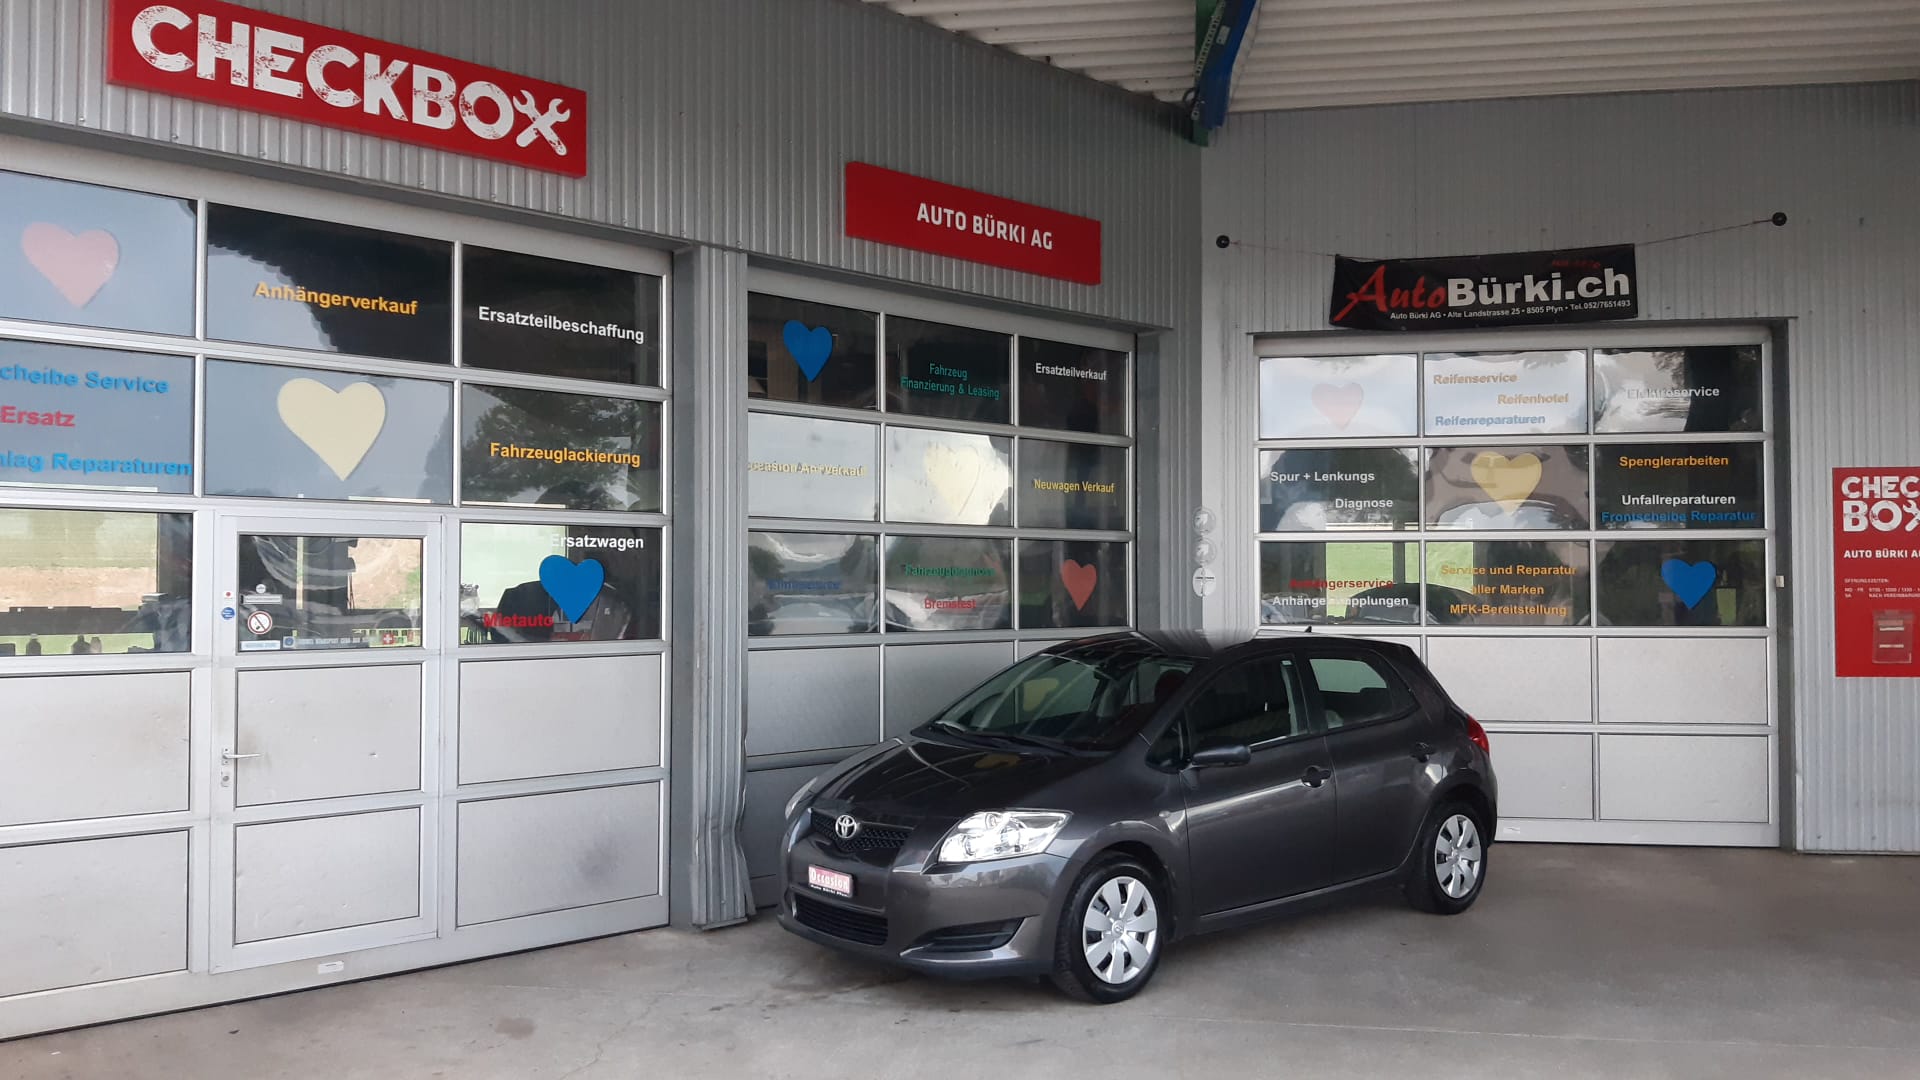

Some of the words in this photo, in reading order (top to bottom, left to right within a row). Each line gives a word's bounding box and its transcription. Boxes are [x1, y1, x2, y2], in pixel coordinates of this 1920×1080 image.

[131, 5, 571, 156] CHECKBOX
[917, 203, 967, 231] AUTO
[973, 214, 1025, 244] BÜRKI
[1031, 229, 1052, 250] AG
[255, 281, 418, 315] Anhängerverkauf
[1390, 312, 1408, 320] Auto
[1409, 311, 1429, 319] Bürki
[1463, 308, 1510, 318] Landstrasse
[1511, 307, 1521, 316] 25
[1526, 306, 1545, 315] 8505
[1545, 306, 1563, 315] Pfyn
[478, 306, 644, 344] Ersatzteilbeschaffung
[929, 363, 968, 381] Fahrzeug
[1035, 363, 1107, 381] Ersatzteilverkauf
[1433, 373, 1517, 385] Reifenservice
[85, 371, 169, 394] Service
[901, 376, 955, 394] Finanzierung
[958, 383, 965, 394] &
[968, 386, 1000, 400] Leasing
[1497, 393, 1569, 405] Reifenhotel
[0, 406, 76, 427] Ersatz
[1435, 414, 1545, 427] Reifenreparaturen
[490, 442, 641, 468] Fahrzeuglackierung
[1619, 456, 1729, 468] Spenglerarbeiten
[52, 452, 193, 476] Reparaturen
[1270, 471, 1300, 483] Spur
[1314, 472, 1375, 483] Lenkungs
[1033, 479, 1080, 493] Neuwagen
[1081, 481, 1115, 493] Verkauf
[1841, 476, 1920, 498] CHEC
[1335, 498, 1393, 510] Diagnose
[1622, 495, 1736, 507] Unfallreparaturen
[1601, 511, 1687, 523] Frontscheibe
[1691, 510, 1756, 523] Reparatur
[551, 533, 644, 551] Ersatzwagen
[1844, 549, 1872, 558] AUTO
[1875, 547, 1908, 558] BÜRKI
[1441, 564, 1486, 575] Service
[1490, 565, 1512, 575] und
[1516, 565, 1576, 576] Reparatur
[1289, 578, 1394, 590] ngerservice
[1472, 584, 1496, 594] aller
[1500, 584, 1544, 595] Marken
[1449, 604, 1567, 616] MFK-Bereitstellung
[483, 613, 554, 628] Mietauto
[811, 868, 848, 890] Occasion
